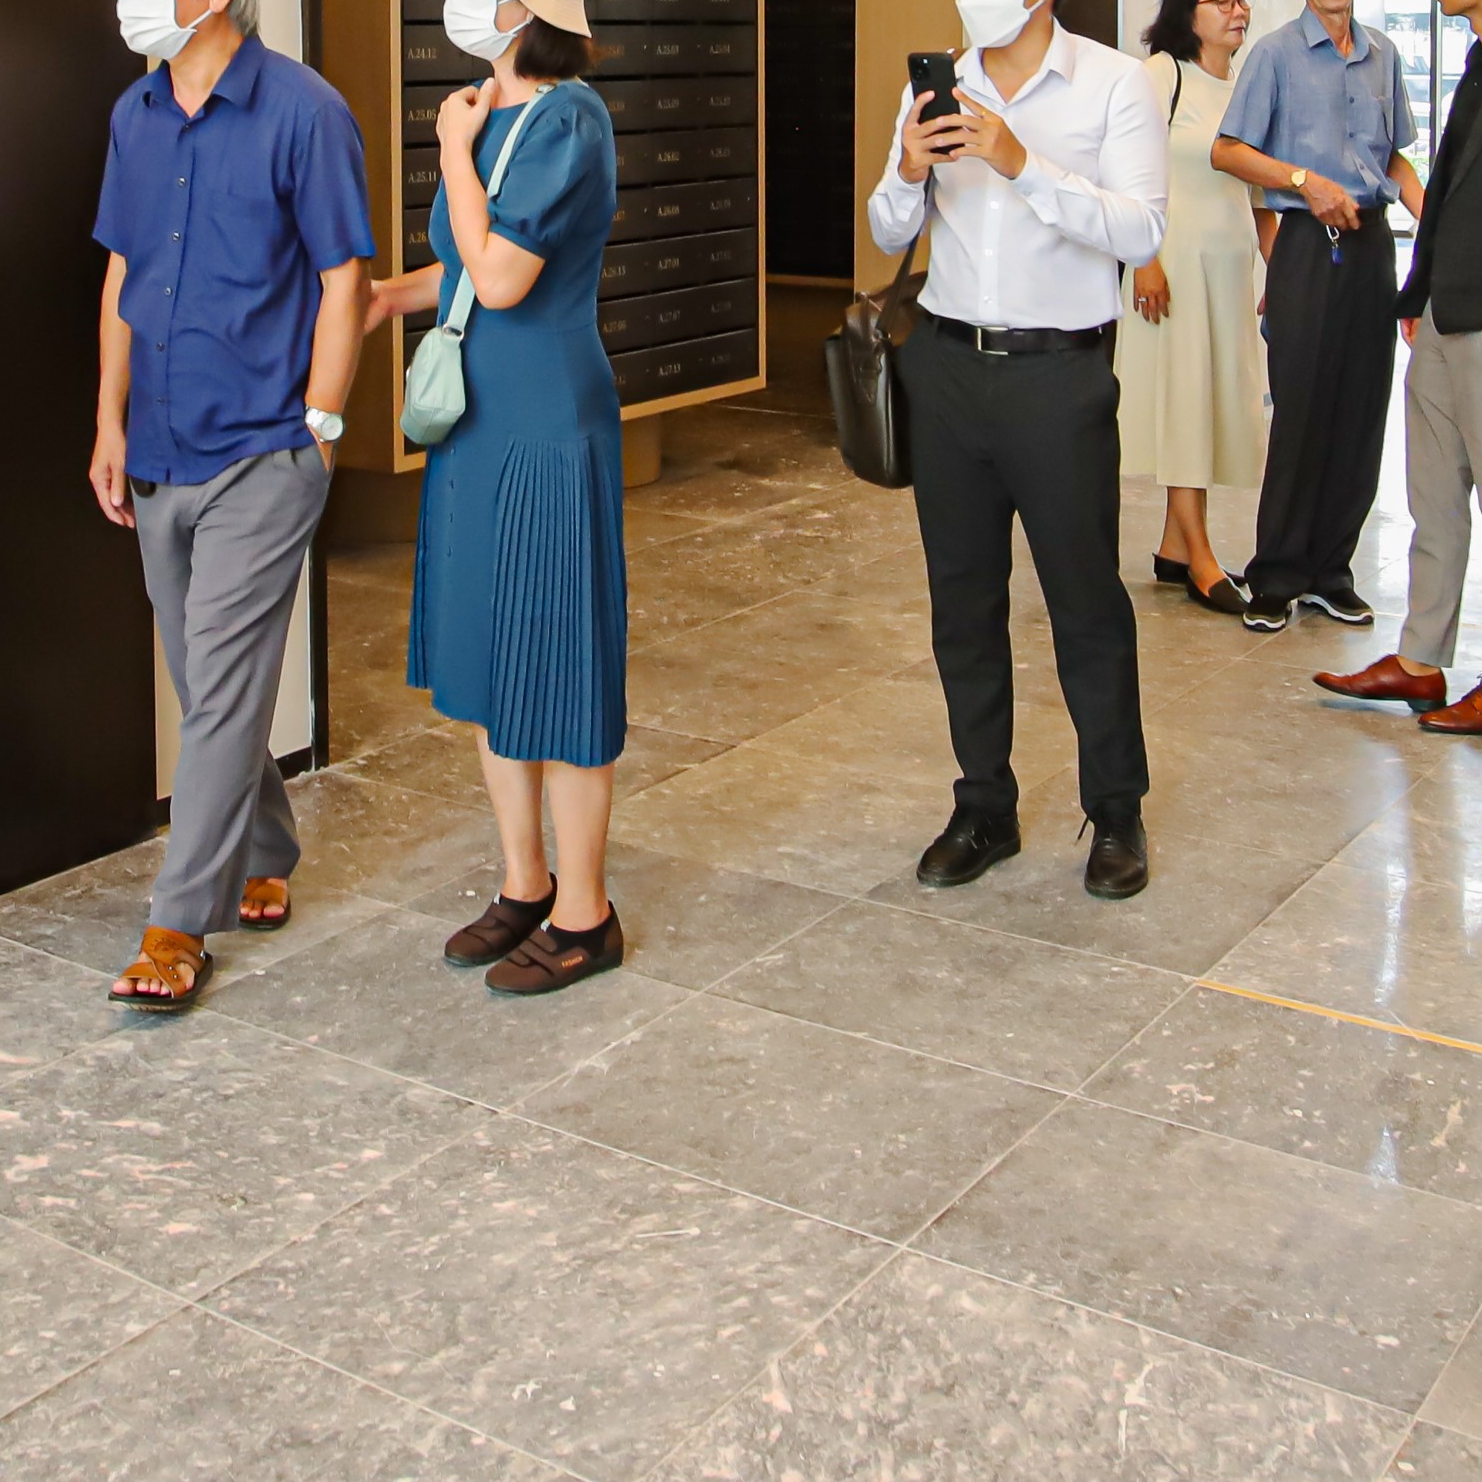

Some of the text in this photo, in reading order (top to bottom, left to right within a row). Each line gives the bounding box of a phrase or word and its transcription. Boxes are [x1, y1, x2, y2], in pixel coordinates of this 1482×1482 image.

[407, 47, 437, 60] A.24.12
[408, 109, 437, 122] A.25.05
[408, 171, 437, 183] A.25.11
[658, 363, 681, 377] A.27.13
